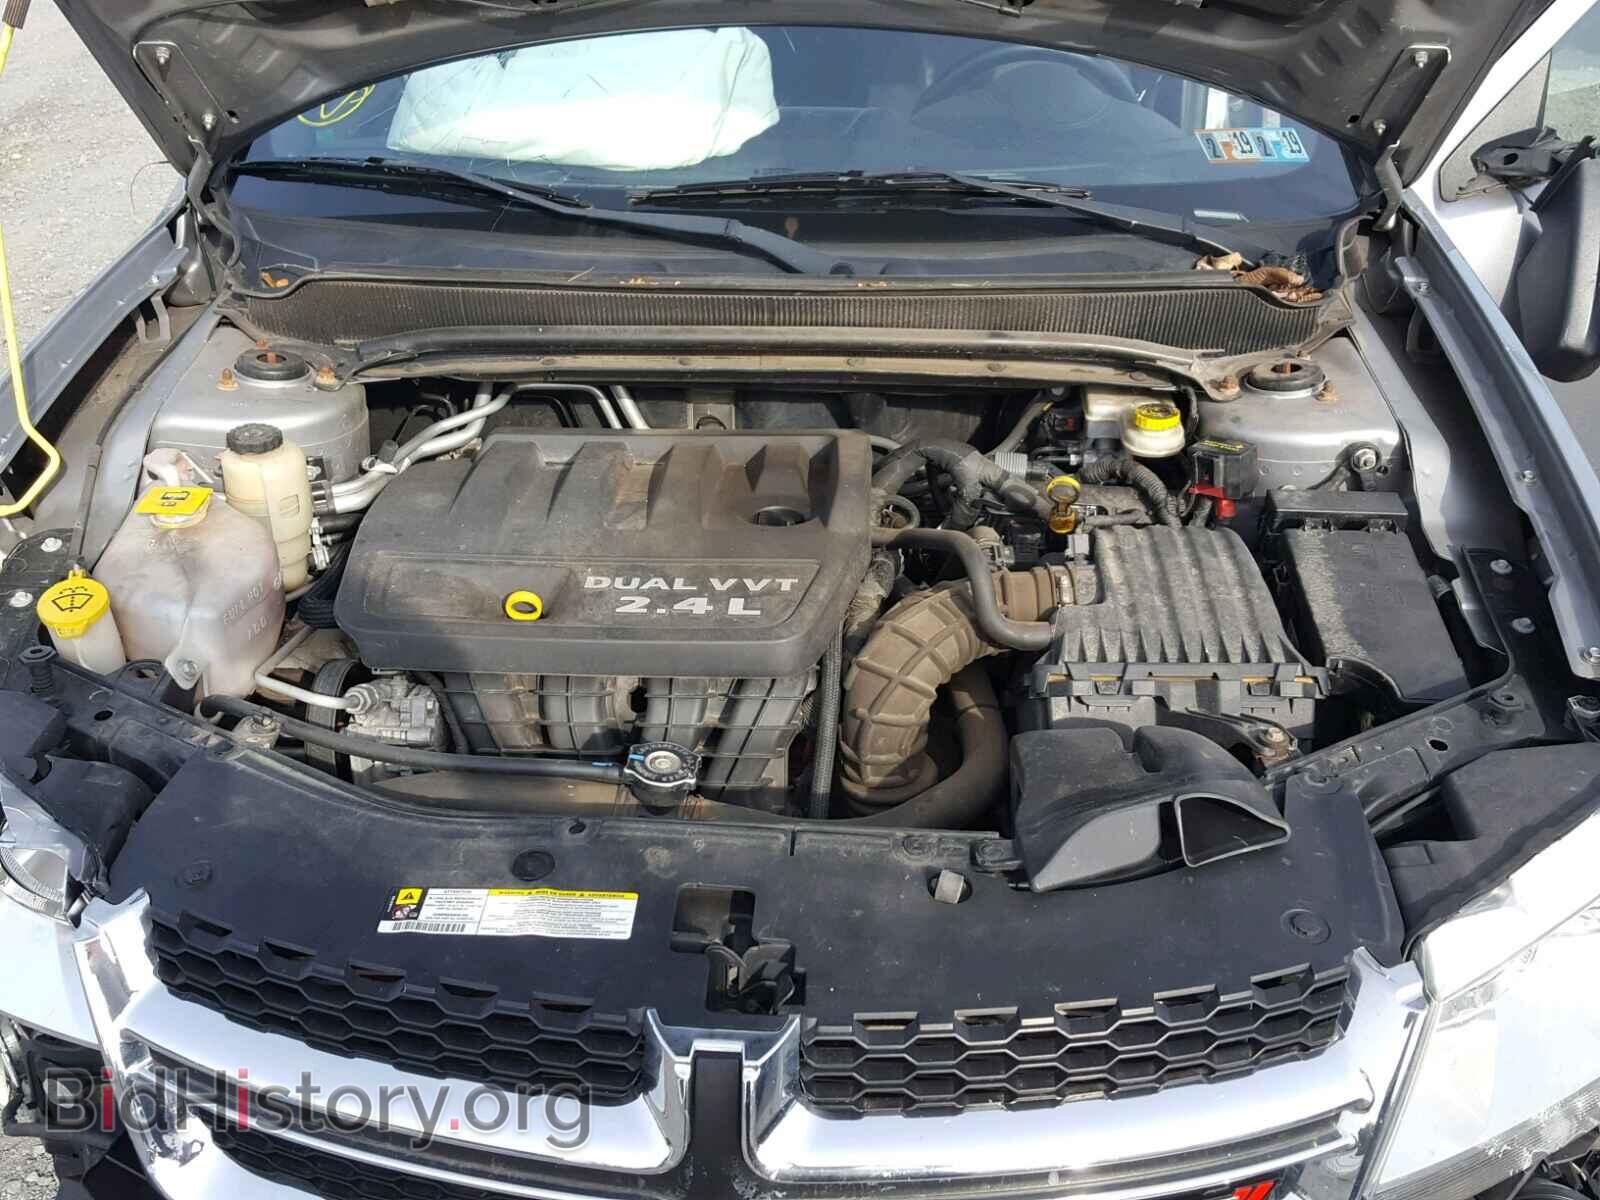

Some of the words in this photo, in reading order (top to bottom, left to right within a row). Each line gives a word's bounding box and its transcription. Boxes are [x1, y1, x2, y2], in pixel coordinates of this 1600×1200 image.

[1233, 131, 1253, 154] 19
[1283, 131, 1302, 154] 19
[584, 576, 697, 590] DUAL
[709, 577, 799, 592] VVT
